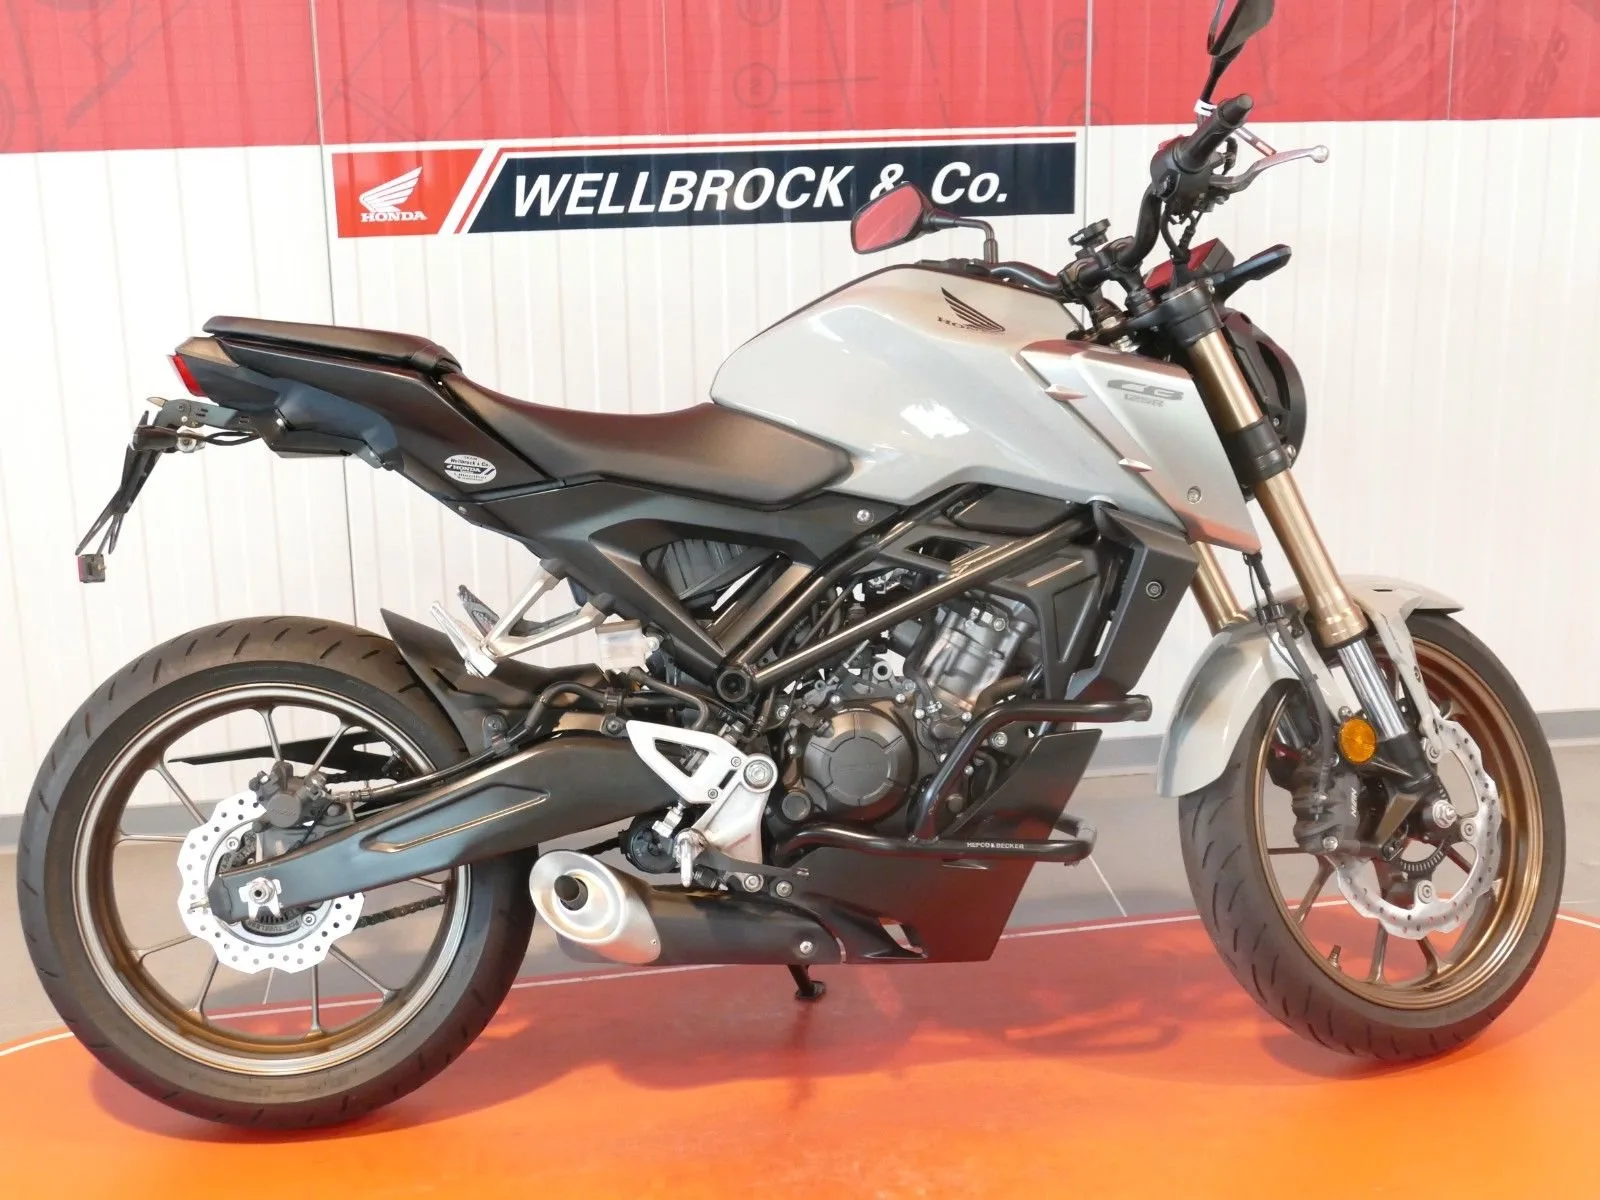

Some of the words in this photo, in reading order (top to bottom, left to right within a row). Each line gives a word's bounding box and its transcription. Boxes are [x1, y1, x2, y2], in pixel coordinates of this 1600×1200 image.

[514, 165, 855, 217] WELLBROCK
[931, 161, 1008, 204] Co.
[360, 211, 428, 222] HONDA
[1107, 379, 1184, 400] CB
